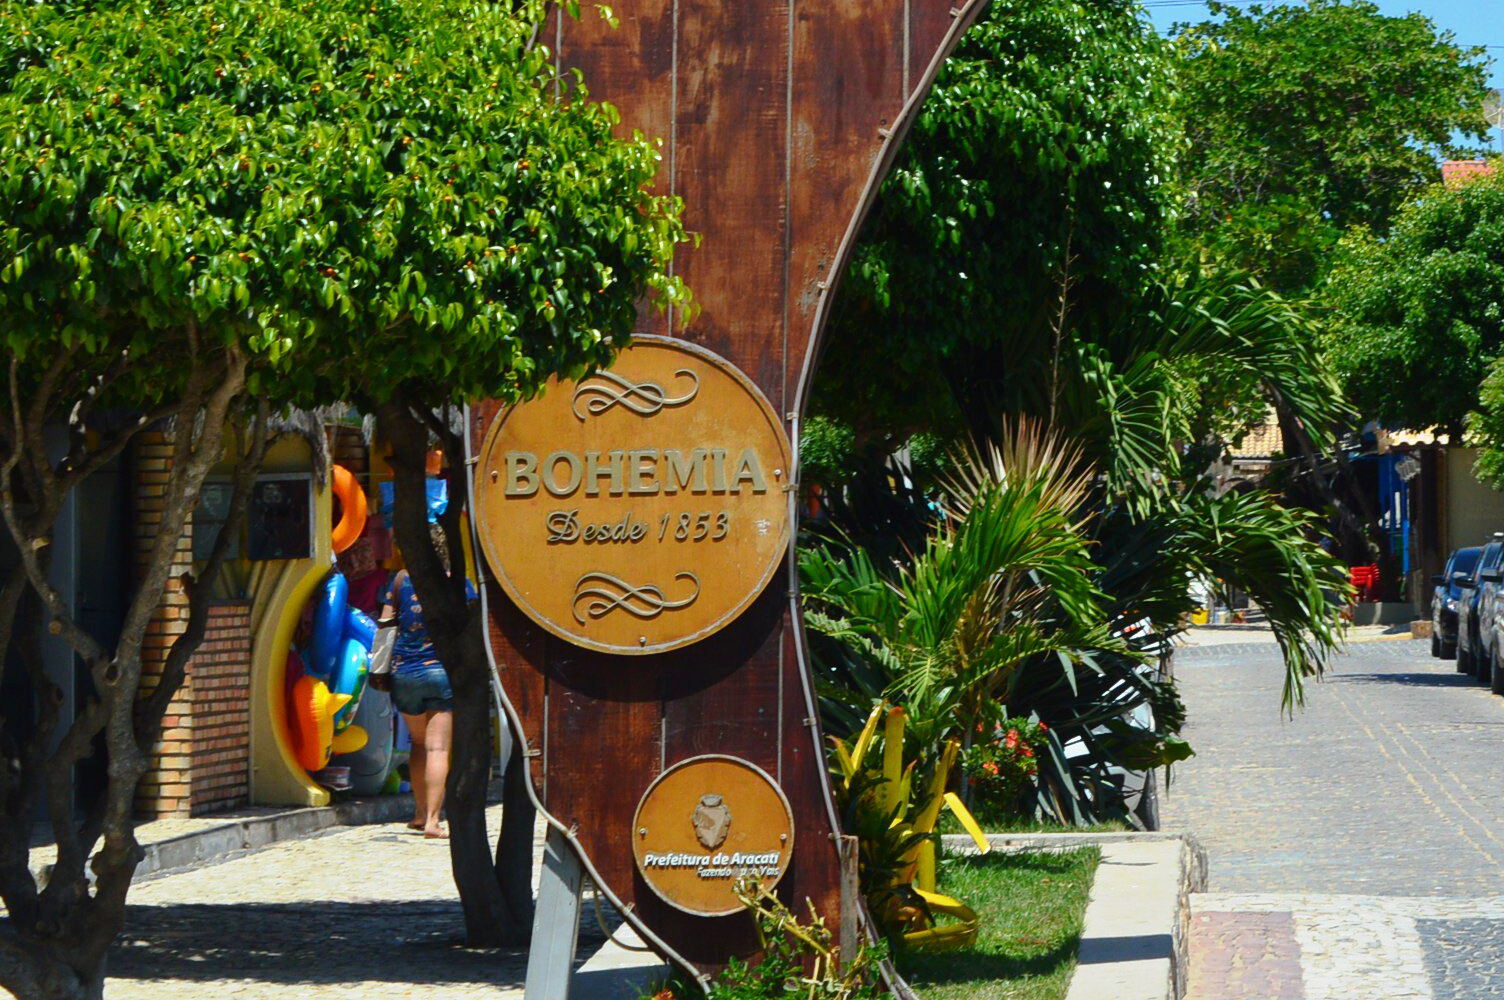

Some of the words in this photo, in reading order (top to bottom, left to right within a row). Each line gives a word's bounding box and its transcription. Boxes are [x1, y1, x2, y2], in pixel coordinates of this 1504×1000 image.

[504, 447, 768, 497] BOHEMIA
[546, 508, 647, 544] Desde
[656, 510, 731, 542] 1853
[643, 852, 710, 866] Prefeitura
[711, 852, 730, 866] de
[730, 851, 780, 865] Aracati
